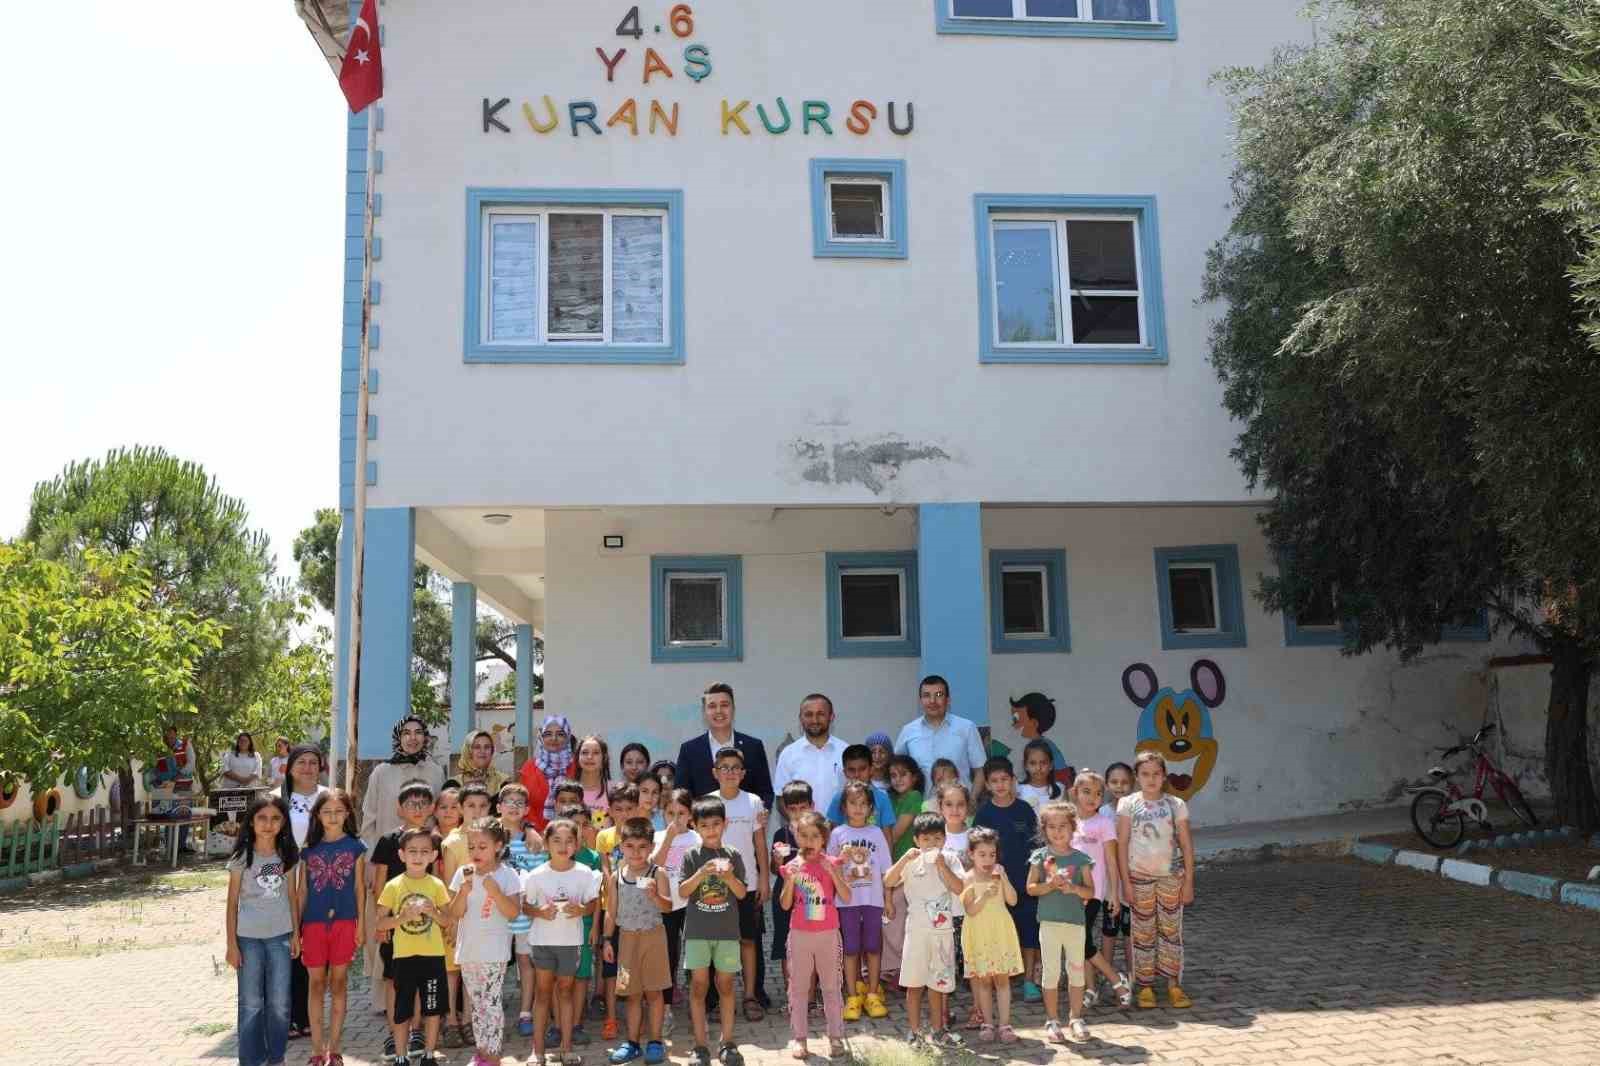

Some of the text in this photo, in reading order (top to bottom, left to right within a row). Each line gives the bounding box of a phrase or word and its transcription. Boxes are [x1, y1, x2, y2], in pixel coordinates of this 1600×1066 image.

[596, 44, 712, 84] YAŞ
[483, 95, 915, 136] KURAN KURSU
